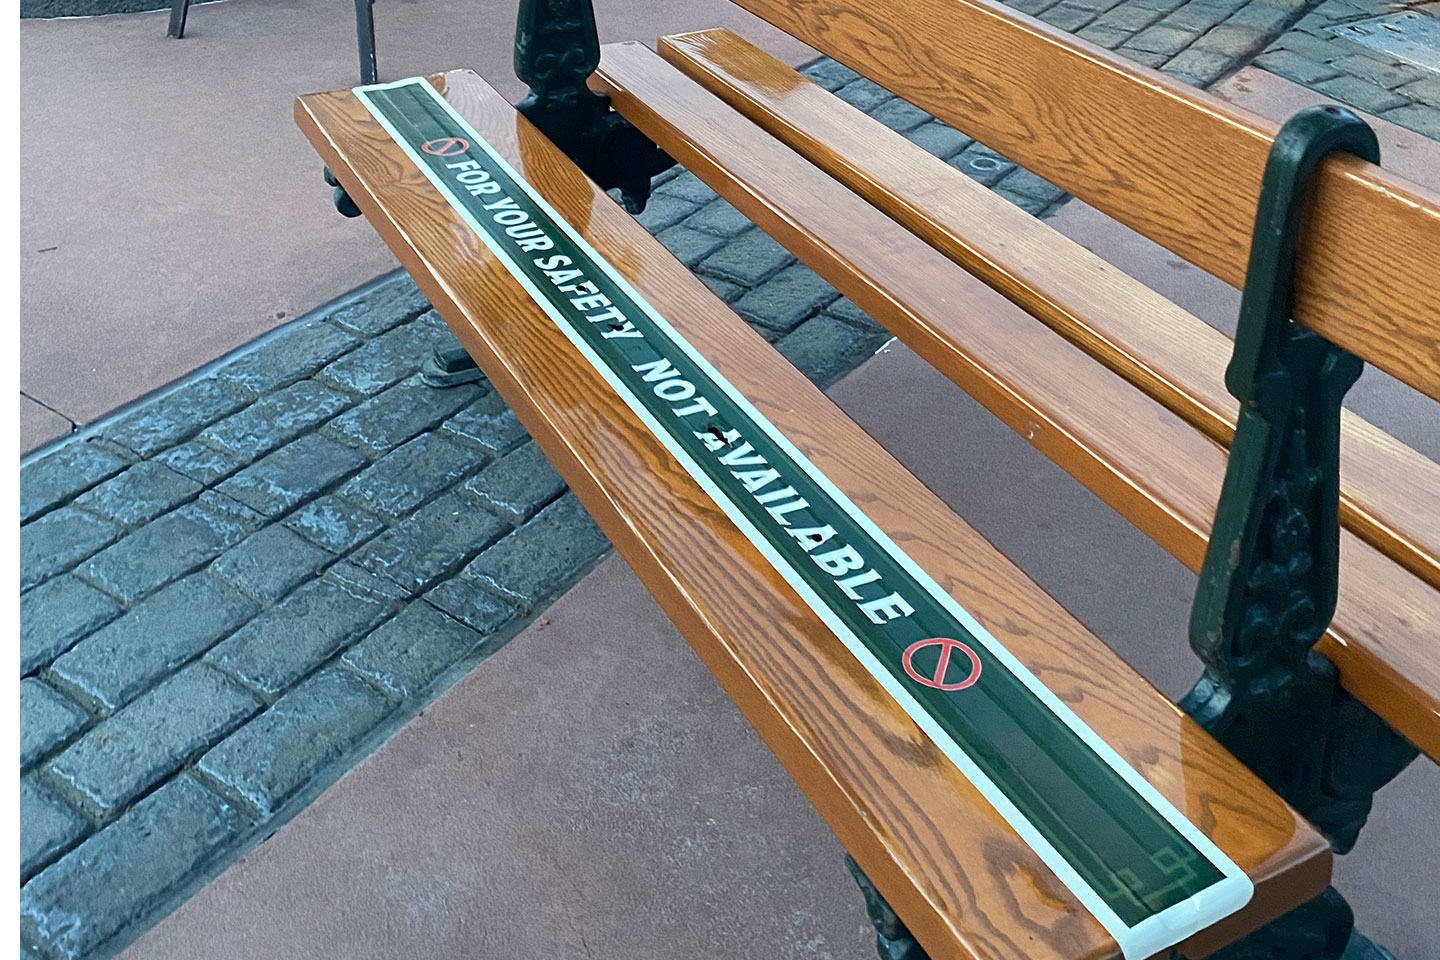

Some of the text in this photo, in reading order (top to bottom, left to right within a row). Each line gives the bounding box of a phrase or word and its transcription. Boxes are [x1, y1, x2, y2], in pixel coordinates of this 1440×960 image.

[445, 159, 916, 625] FOR YOUR SAFETY NOT AVAILABLE
